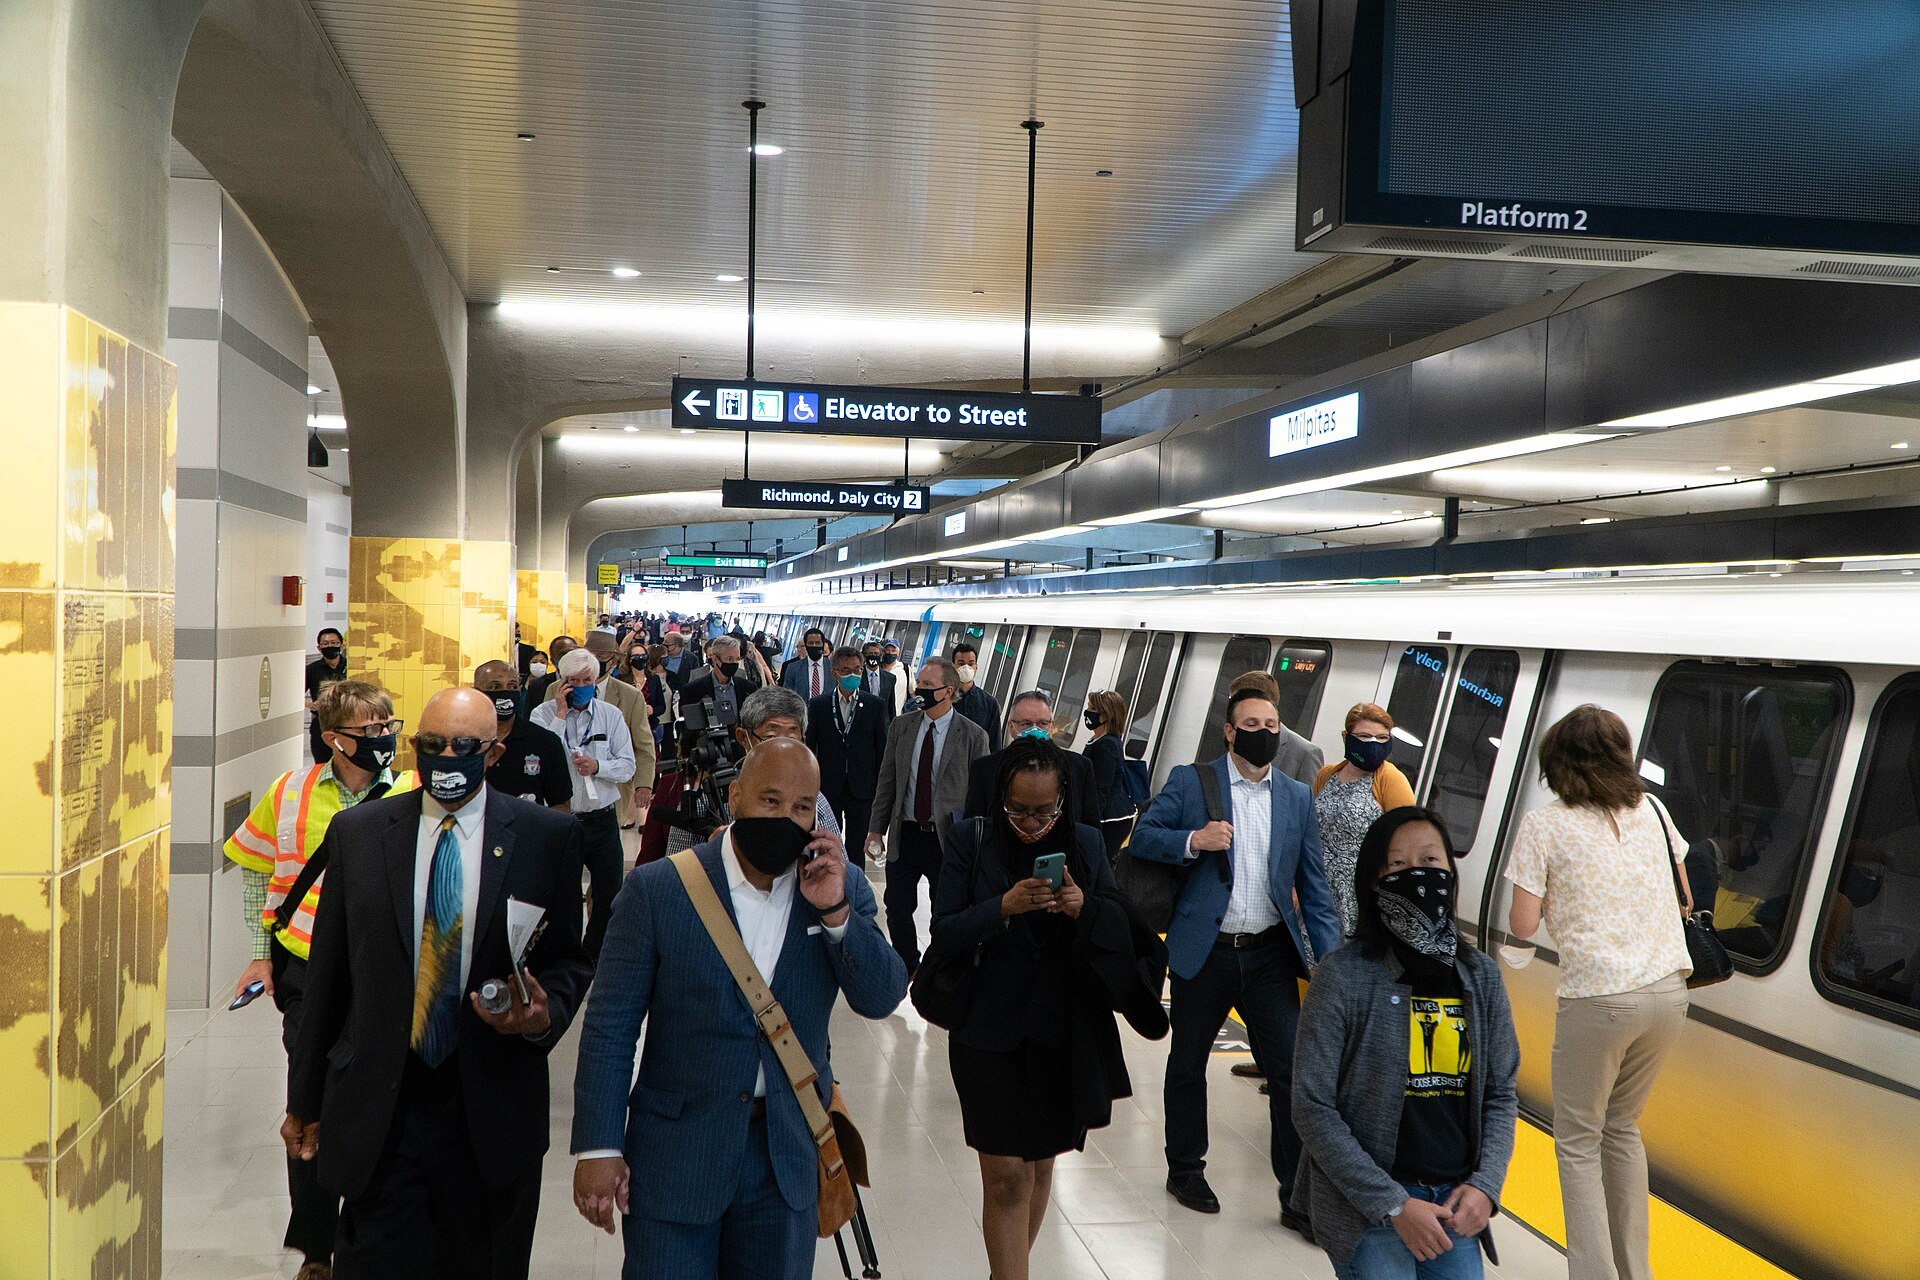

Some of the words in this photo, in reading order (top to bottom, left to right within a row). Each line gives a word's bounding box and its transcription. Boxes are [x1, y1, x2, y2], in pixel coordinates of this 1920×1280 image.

[1461, 202, 1569, 230] Platform
[1573, 209, 1588, 231] 2
[825, 397, 920, 424] Elevator
[927, 403, 951, 424] to
[958, 403, 1027, 427] Street
[1287, 408, 1337, 445] Milpitas
[762, 488, 835, 505] Richmond,
[839, 491, 870, 507] Daly
[873, 492, 901, 508] City
[715, 557, 733, 567] Exit
[1414, 1001, 1439, 1012] LIVES
[1405, 1077, 1432, 1088] HOOSE
